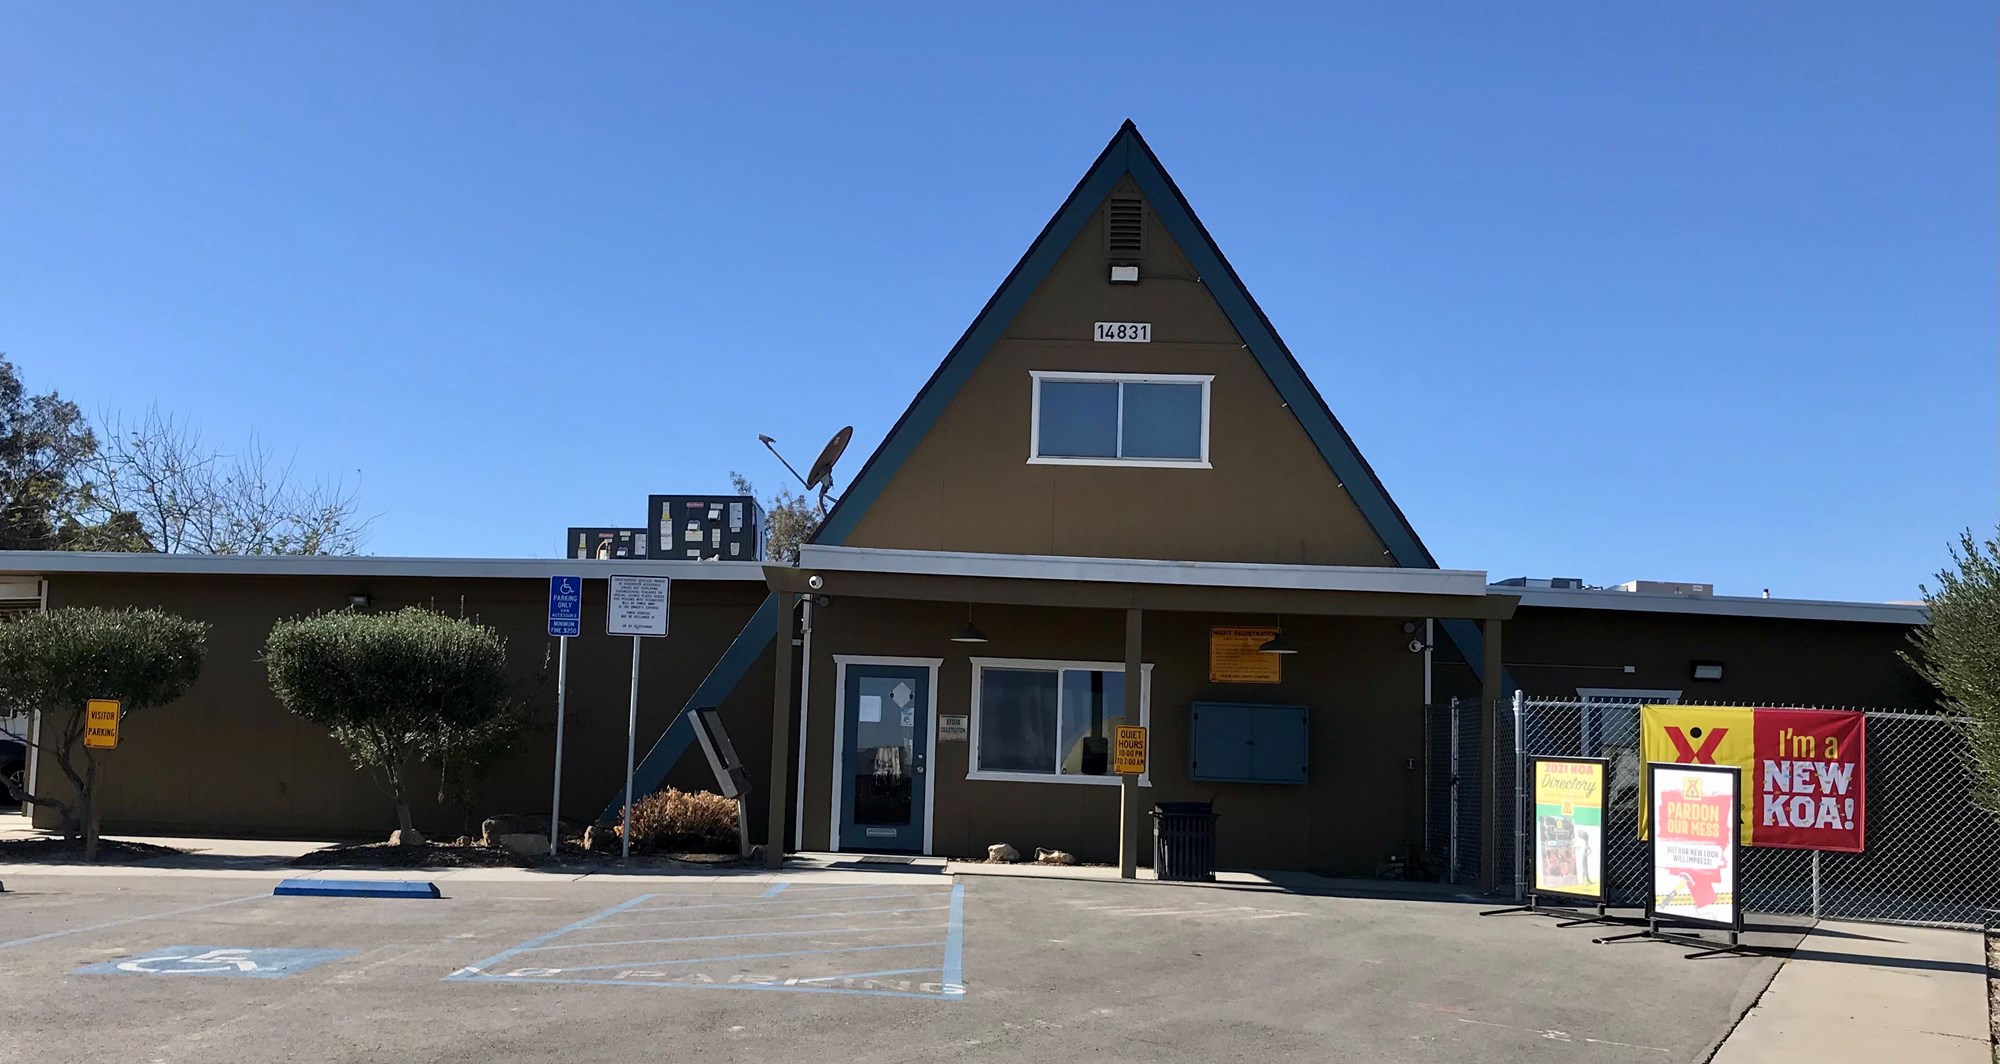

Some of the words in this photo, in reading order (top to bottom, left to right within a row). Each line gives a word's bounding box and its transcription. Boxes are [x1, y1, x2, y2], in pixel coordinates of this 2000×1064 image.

[1097, 324, 1147, 340] 14831
[553, 594, 578, 602] PARKING
[557, 601, 573, 609] ONLY
[91, 711, 115, 720] VISITOR
[946, 718, 961, 726] STORE
[88, 727, 115, 737] PARKING
[1120, 730, 1142, 739] QUIET
[1118, 740, 1144, 749] HOURS
[1779, 727, 1816, 758] I'm
[1824, 736, 1838, 759] a
[1545, 764, 1568, 774] 2021
[1571, 765, 1594, 775] KOA
[1763, 759, 1855, 795] NEW
[1541, 773, 1597, 799] Directory
[1667, 801, 1719, 822] PARDON
[1763, 794, 1855, 831] KOA!
[1667, 819, 1689, 835] OUR
[1690, 821, 1720, 838] MESS
[1678, 847, 1689, 855] OUR
[1690, 848, 1703, 857] NEW
[1703, 850, 1719, 859] LOOK
[1673, 854, 1686, 863] WILL
[1686, 856, 1713, 866] IMPRESS!
[610, 969, 967, 995] PARKING
